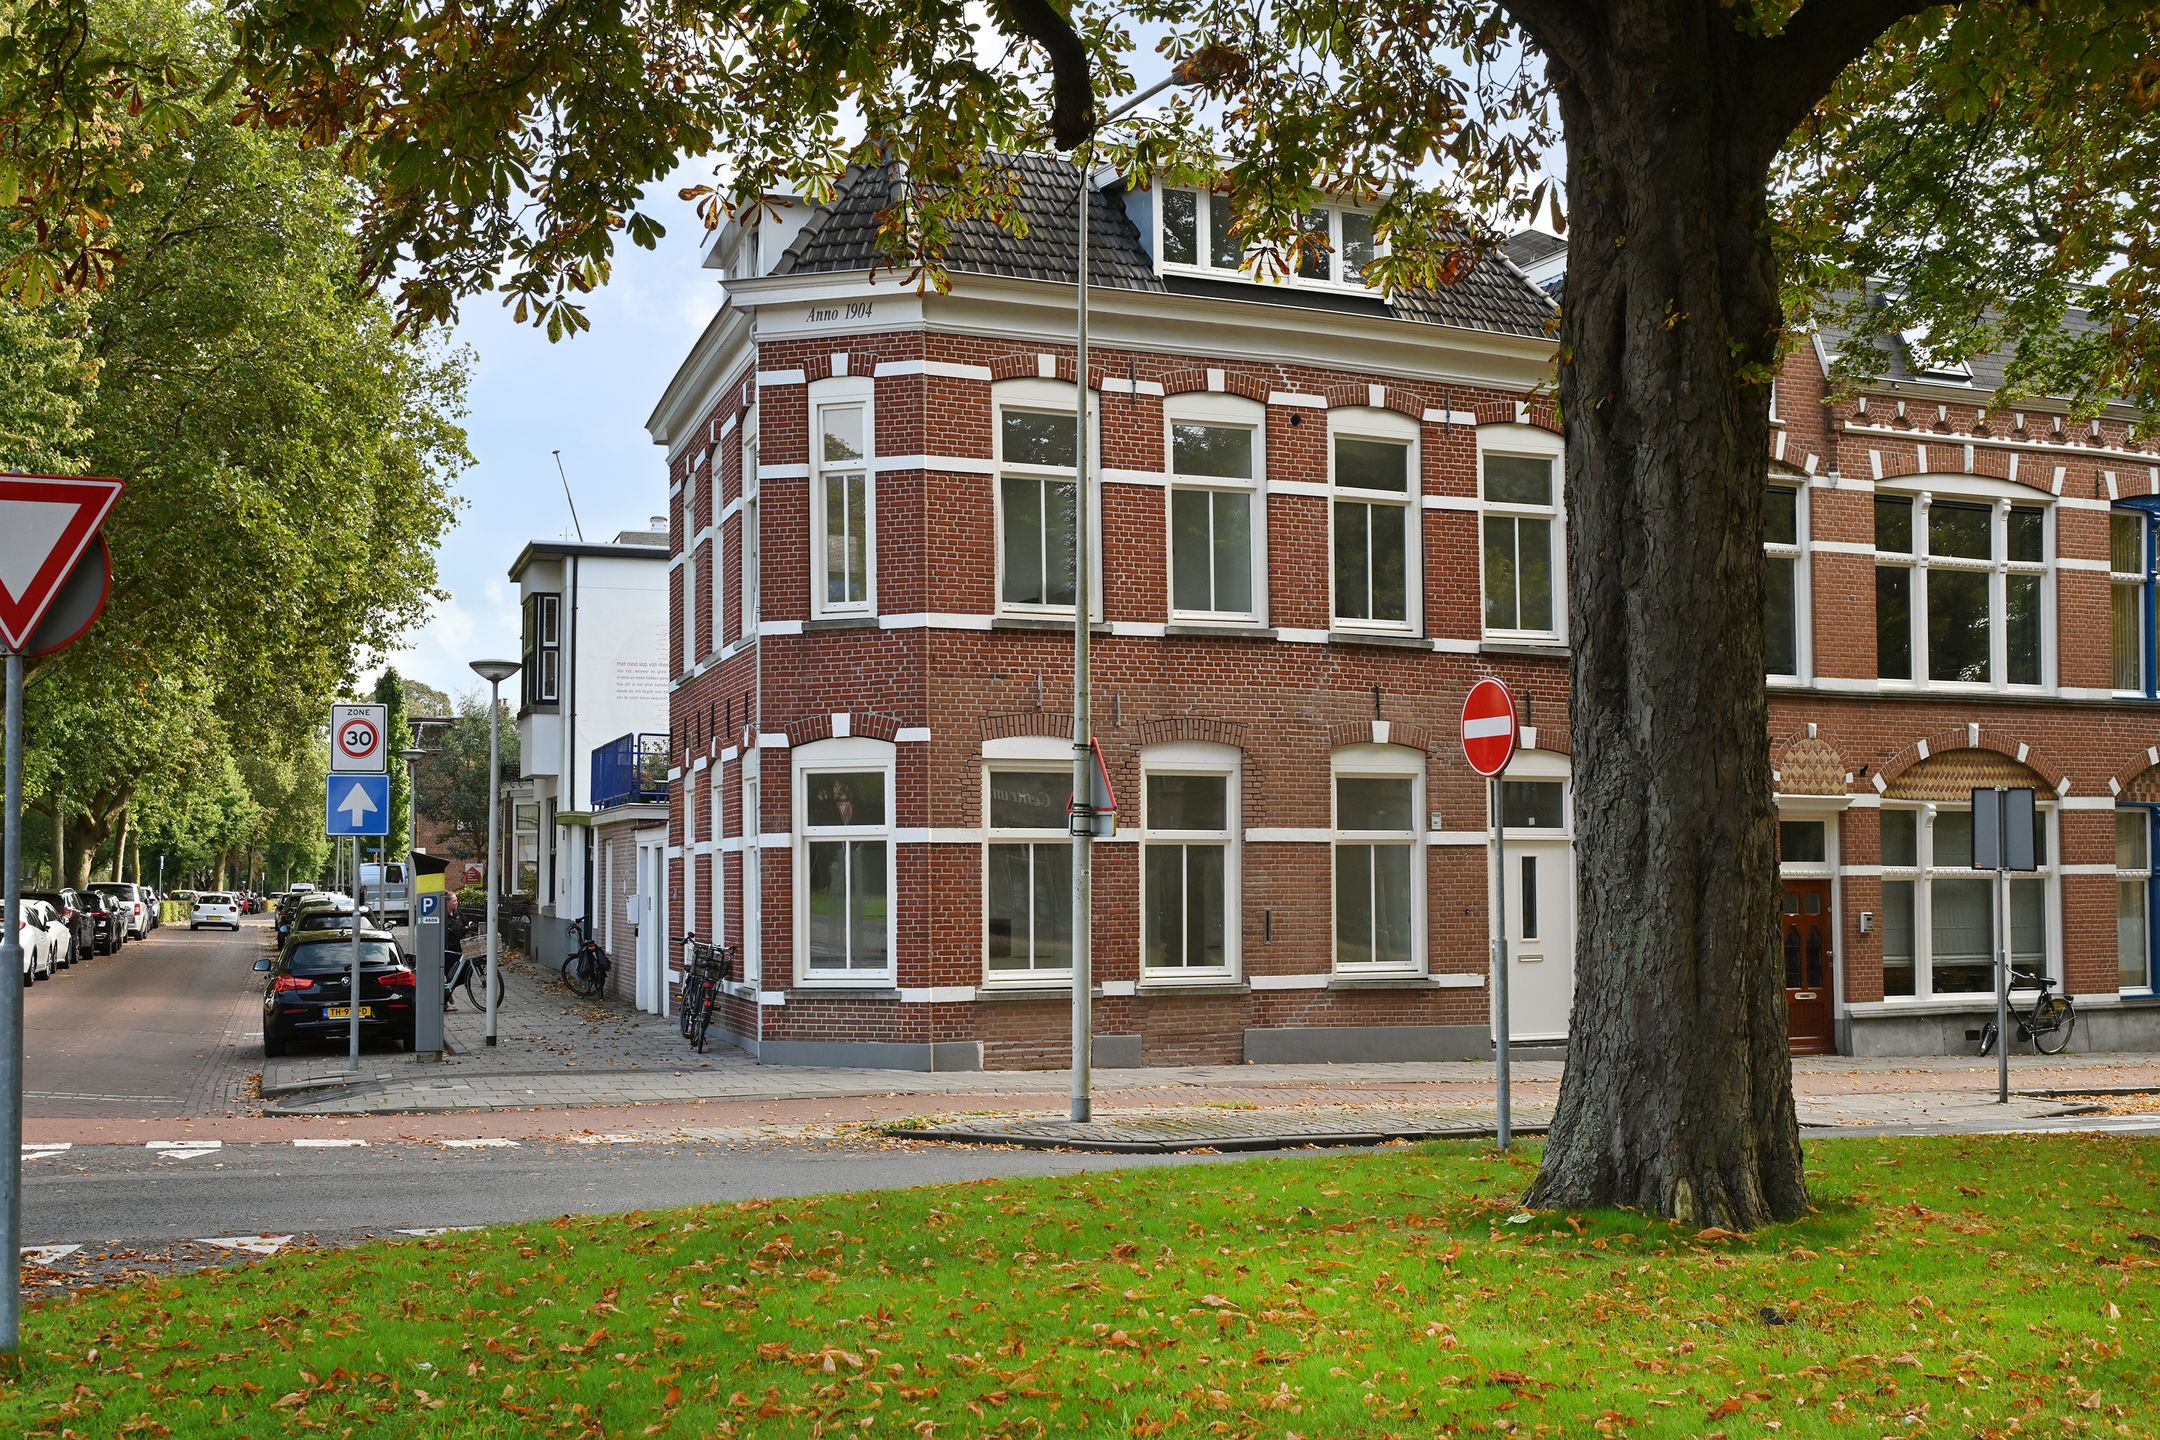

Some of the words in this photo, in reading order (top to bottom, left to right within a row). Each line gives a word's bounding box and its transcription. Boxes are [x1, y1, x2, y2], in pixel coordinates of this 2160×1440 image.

[806, 307, 839, 322] Anno
[844, 301, 873, 319] 1904
[345, 731, 372, 746] 30
[423, 897, 433, 913] P
[330, 1007, 368, 1016] TH-9-D
